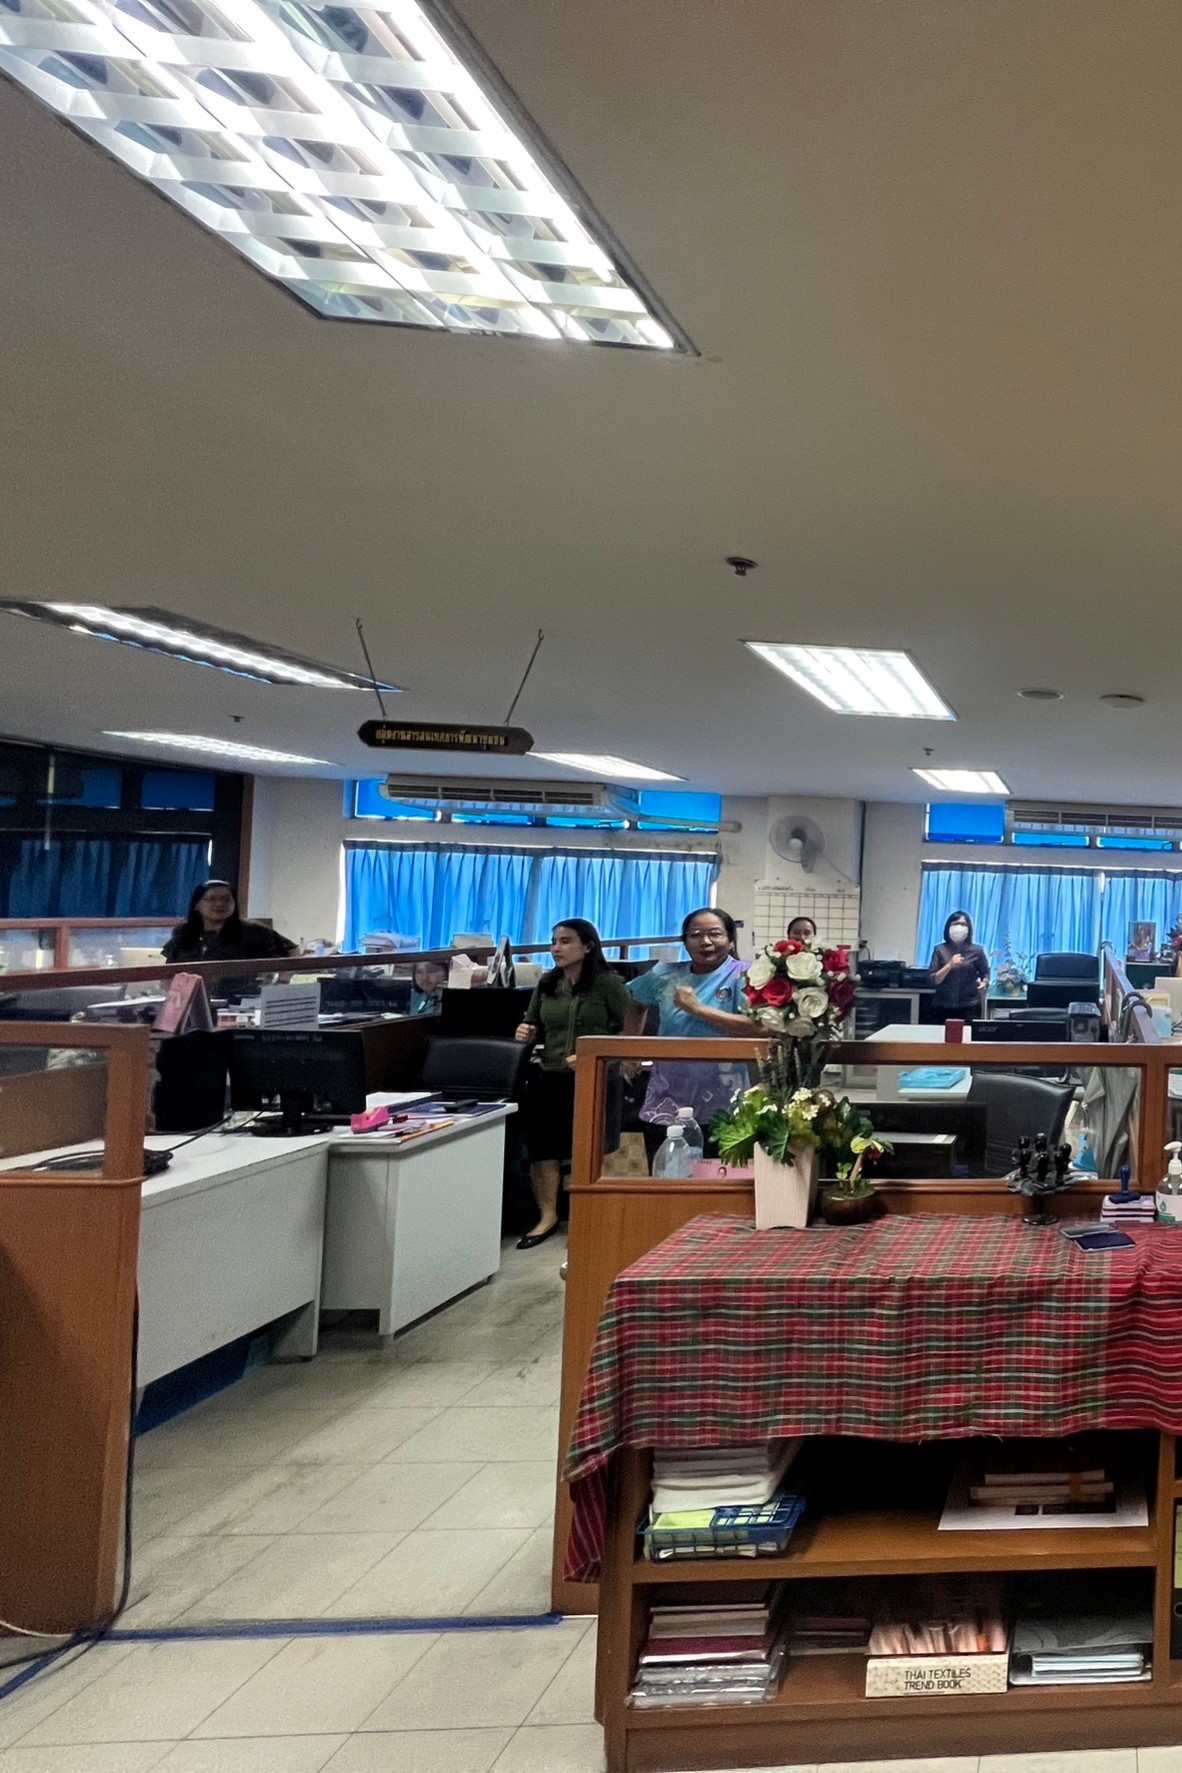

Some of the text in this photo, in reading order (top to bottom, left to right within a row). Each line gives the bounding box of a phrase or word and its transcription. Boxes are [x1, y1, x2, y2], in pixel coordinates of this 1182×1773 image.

[904, 1668, 971, 1680] THAI TEXTILES
[904, 1679, 962, 1691] TREND BOOK
